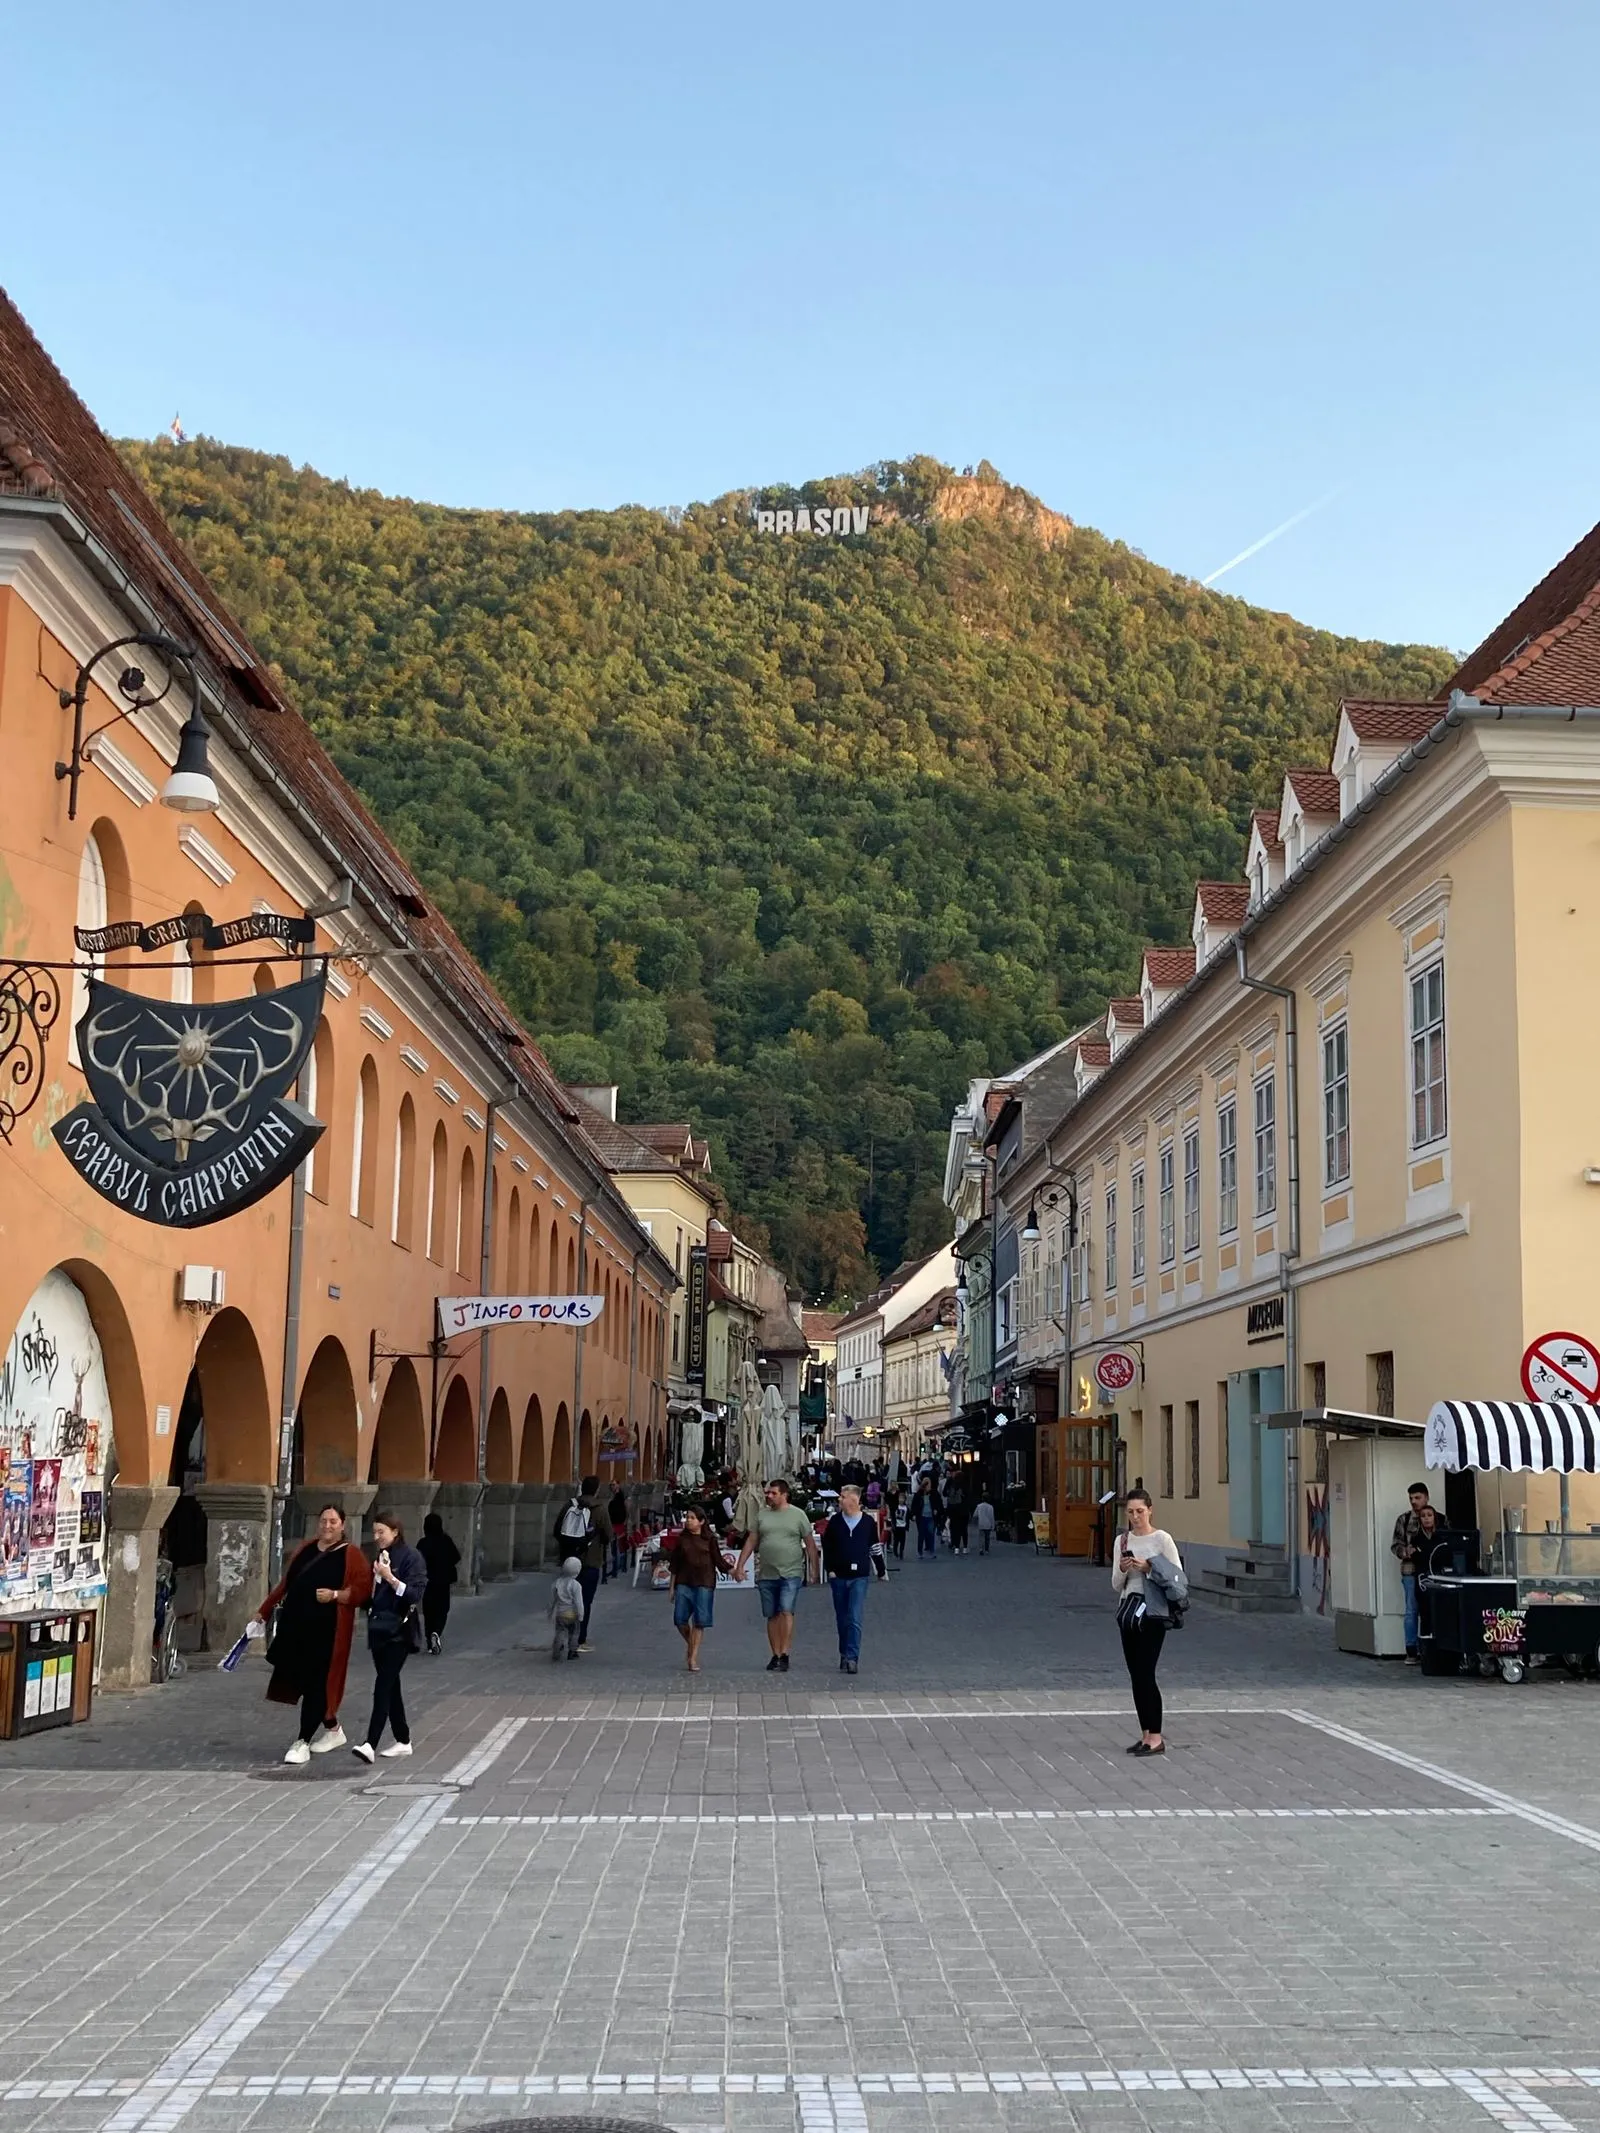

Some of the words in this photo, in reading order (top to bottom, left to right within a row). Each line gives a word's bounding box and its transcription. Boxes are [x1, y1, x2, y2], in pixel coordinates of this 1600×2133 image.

[758, 506, 869, 537] BRASOV
[222, 916, 290, 945] BRASERIE
[63, 1117, 151, 1213] CERBUL
[161, 1110, 295, 1220] CARPATIN
[453, 1302, 523, 1327] J'INFO
[528, 1301, 592, 1319] TOURS
[1247, 1297, 1284, 1334] MUSEUM
